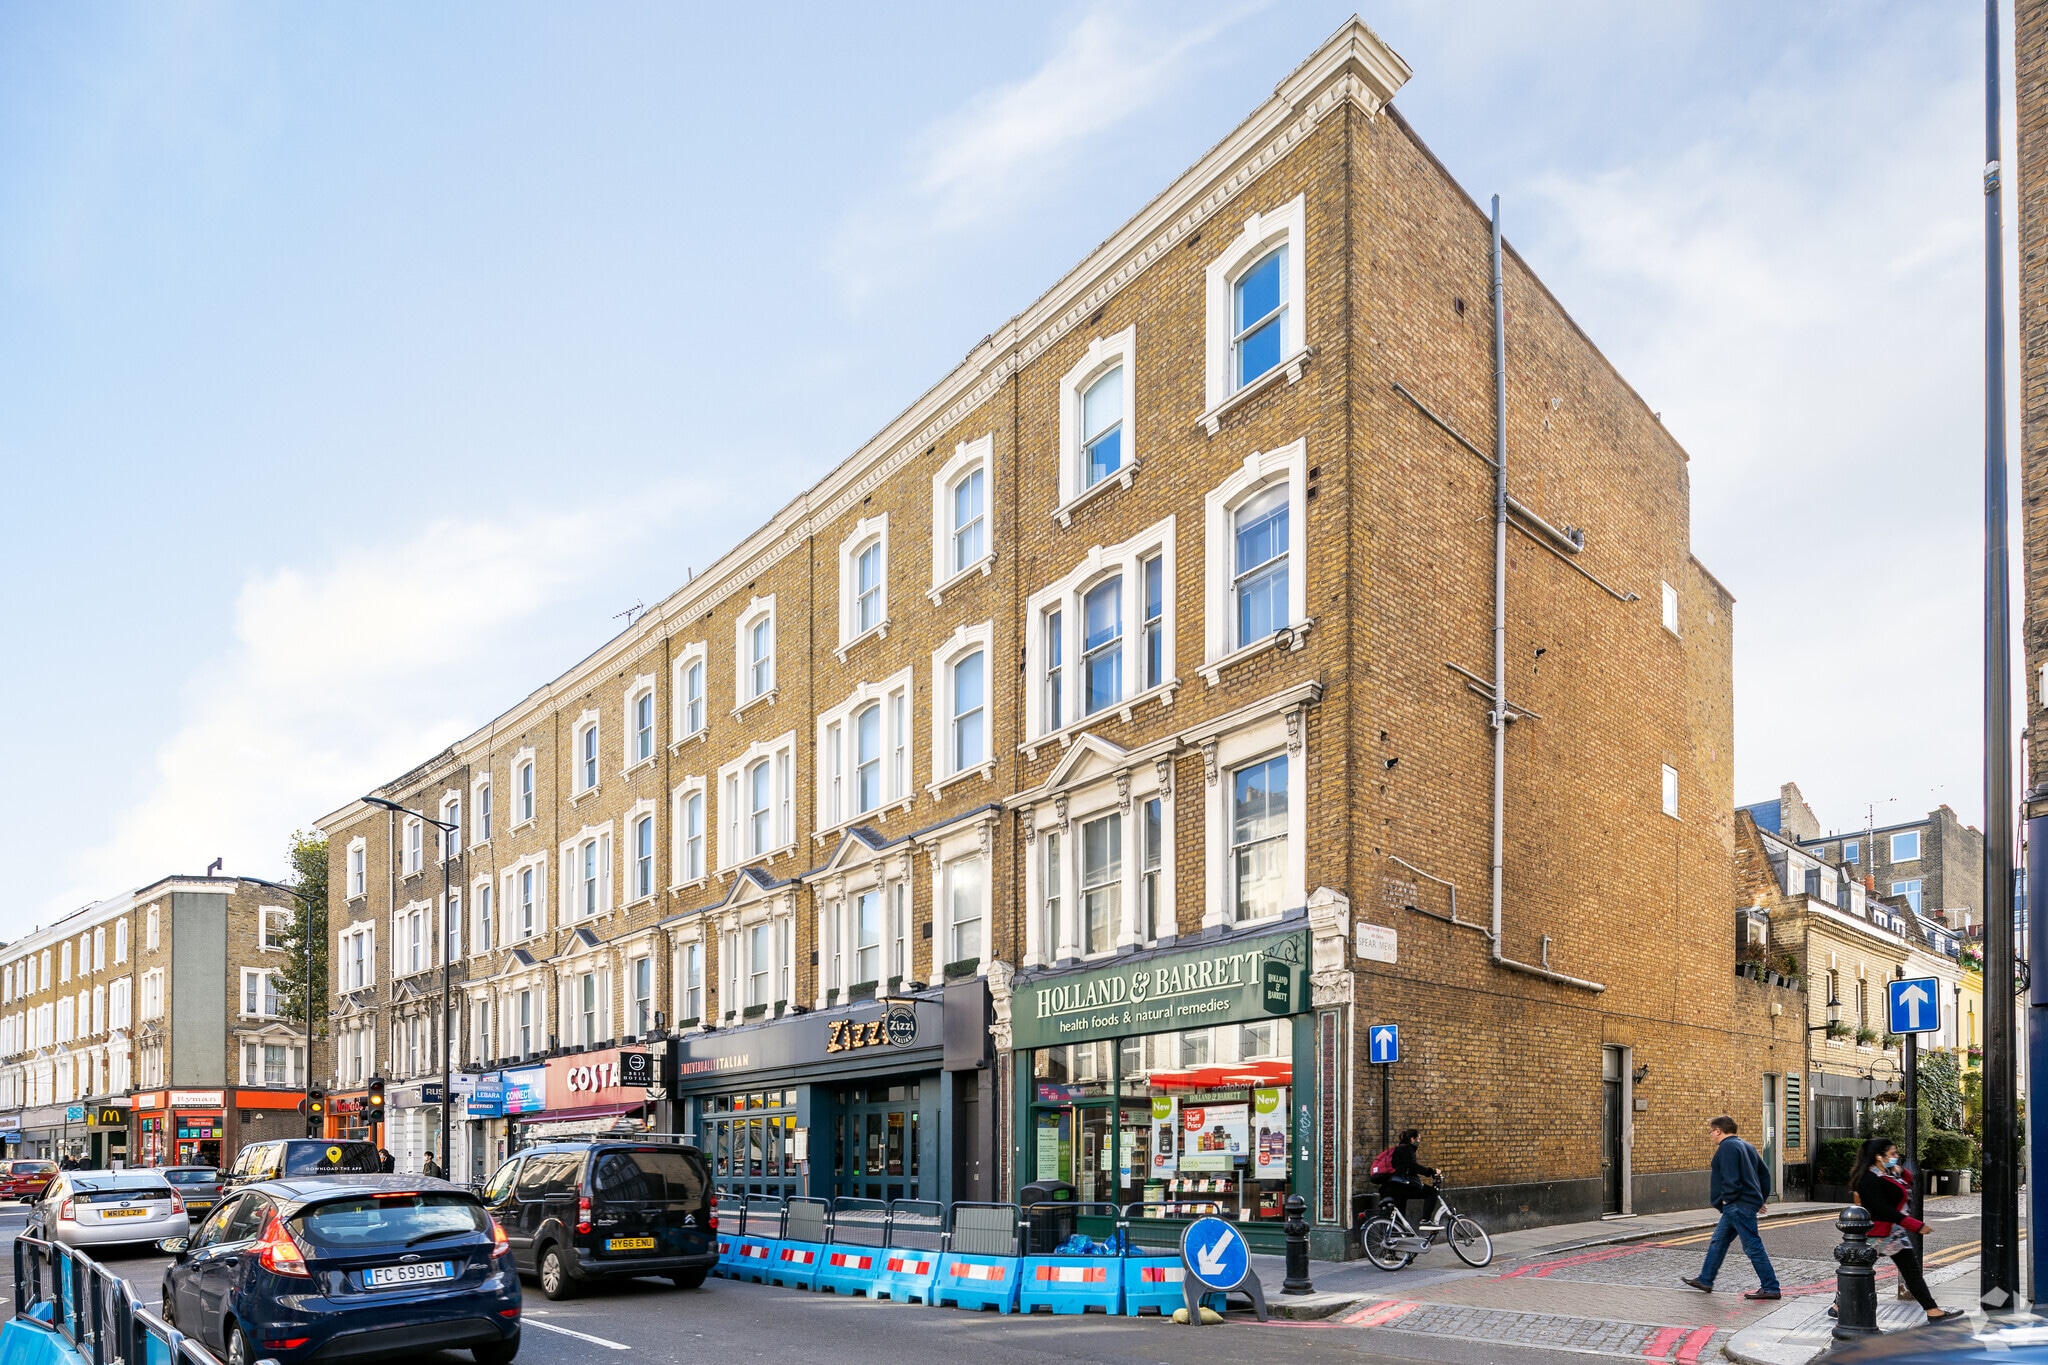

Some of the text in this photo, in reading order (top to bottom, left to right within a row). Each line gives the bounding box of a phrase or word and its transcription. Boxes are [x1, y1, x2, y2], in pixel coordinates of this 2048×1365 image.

[1358, 937, 1396, 952] SPEAR MEWS
[1036, 950, 1265, 1019] HOLLAND & BARRETT
[1268, 973, 1288, 985] HOLLAND
[1275, 983, 1281, 993] &
[1267, 989, 1288, 1002] BARRETT
[1060, 998, 1230, 1033] health foods & natural remedies
[889, 1020, 914, 1031] Zizzi
[826, 1012, 889, 1053] Zizzi
[892, 1034, 913, 1044] ITALIAN
[567, 1061, 619, 1094] COSTA
[425, 1088, 443, 1096] RUS
[476, 1091, 500, 1099] LEBARA
[506, 1089, 531, 1101] CONNECT
[1189, 1094, 1212, 1102] HOLLAND
[1217, 1092, 1241, 1100] BARRETT
[1257, 1094, 1277, 1105] New
[1153, 1102, 1170, 1111] New
[1187, 1114, 1201, 1122] Half
[1187, 1121, 1201, 1129] Price
[107, 1209, 143, 1218] WR12 LZP
[611, 1237, 652, 1248] HY66 ENU
[375, 1263, 444, 1284] FC 699GM
